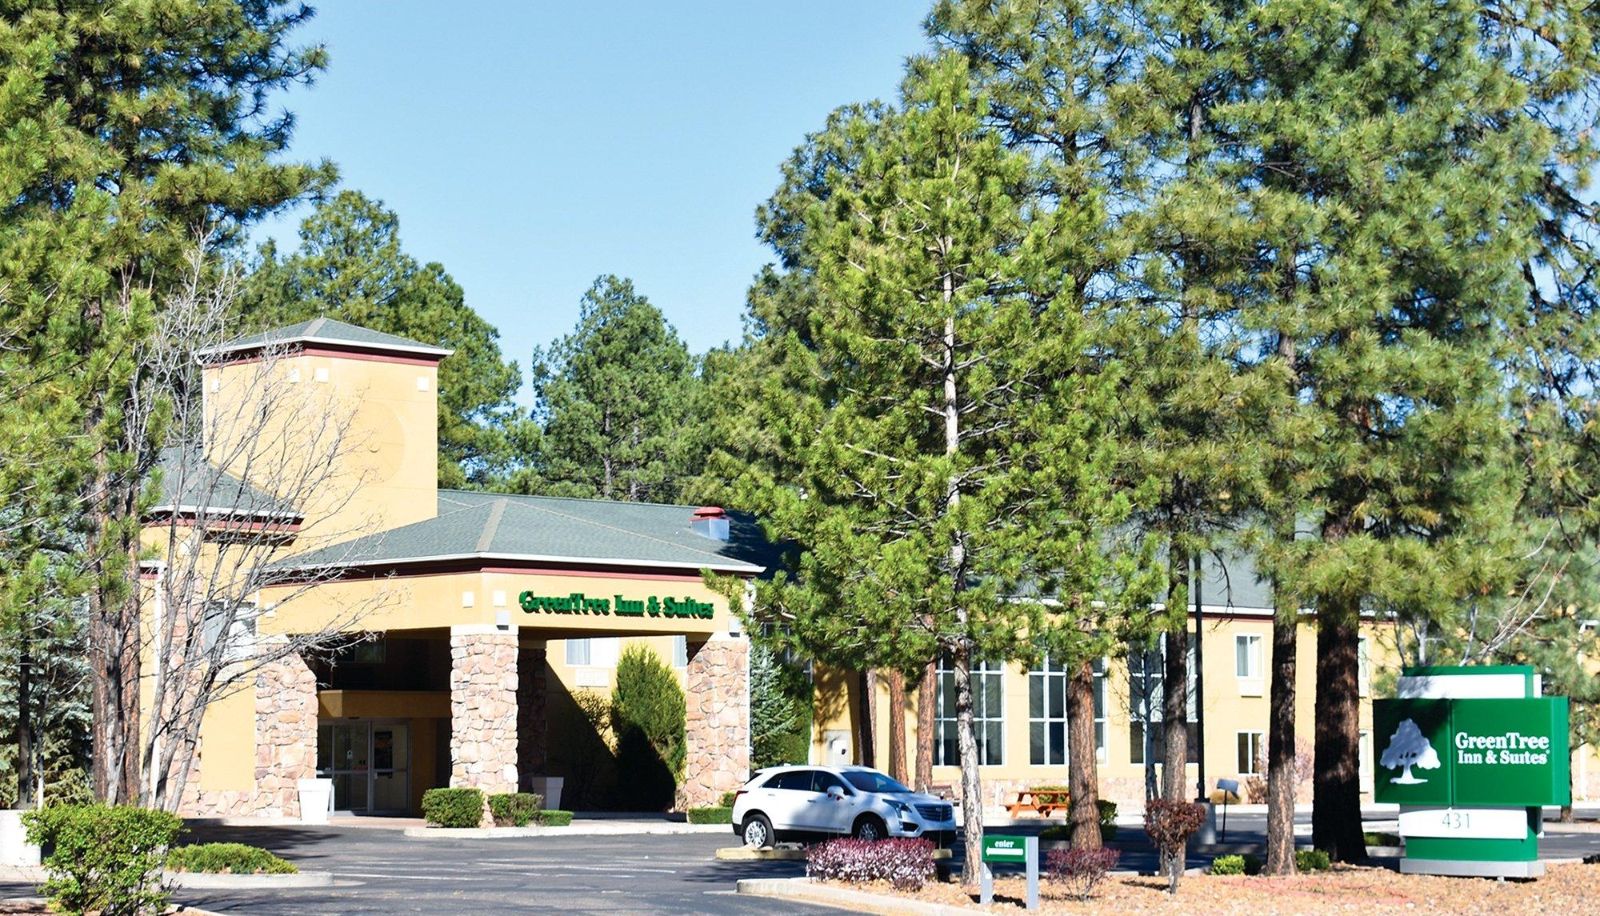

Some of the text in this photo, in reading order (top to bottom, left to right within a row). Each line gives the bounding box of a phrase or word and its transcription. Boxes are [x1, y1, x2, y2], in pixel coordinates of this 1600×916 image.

[519, 591, 714, 619] GreenTree Inn & Suites
[1455, 732, 1549, 749] GreenTree
[1458, 750, 1548, 764] Inn & Suites
[1441, 812, 1471, 829] 431
[994, 840, 1015, 848] enter
